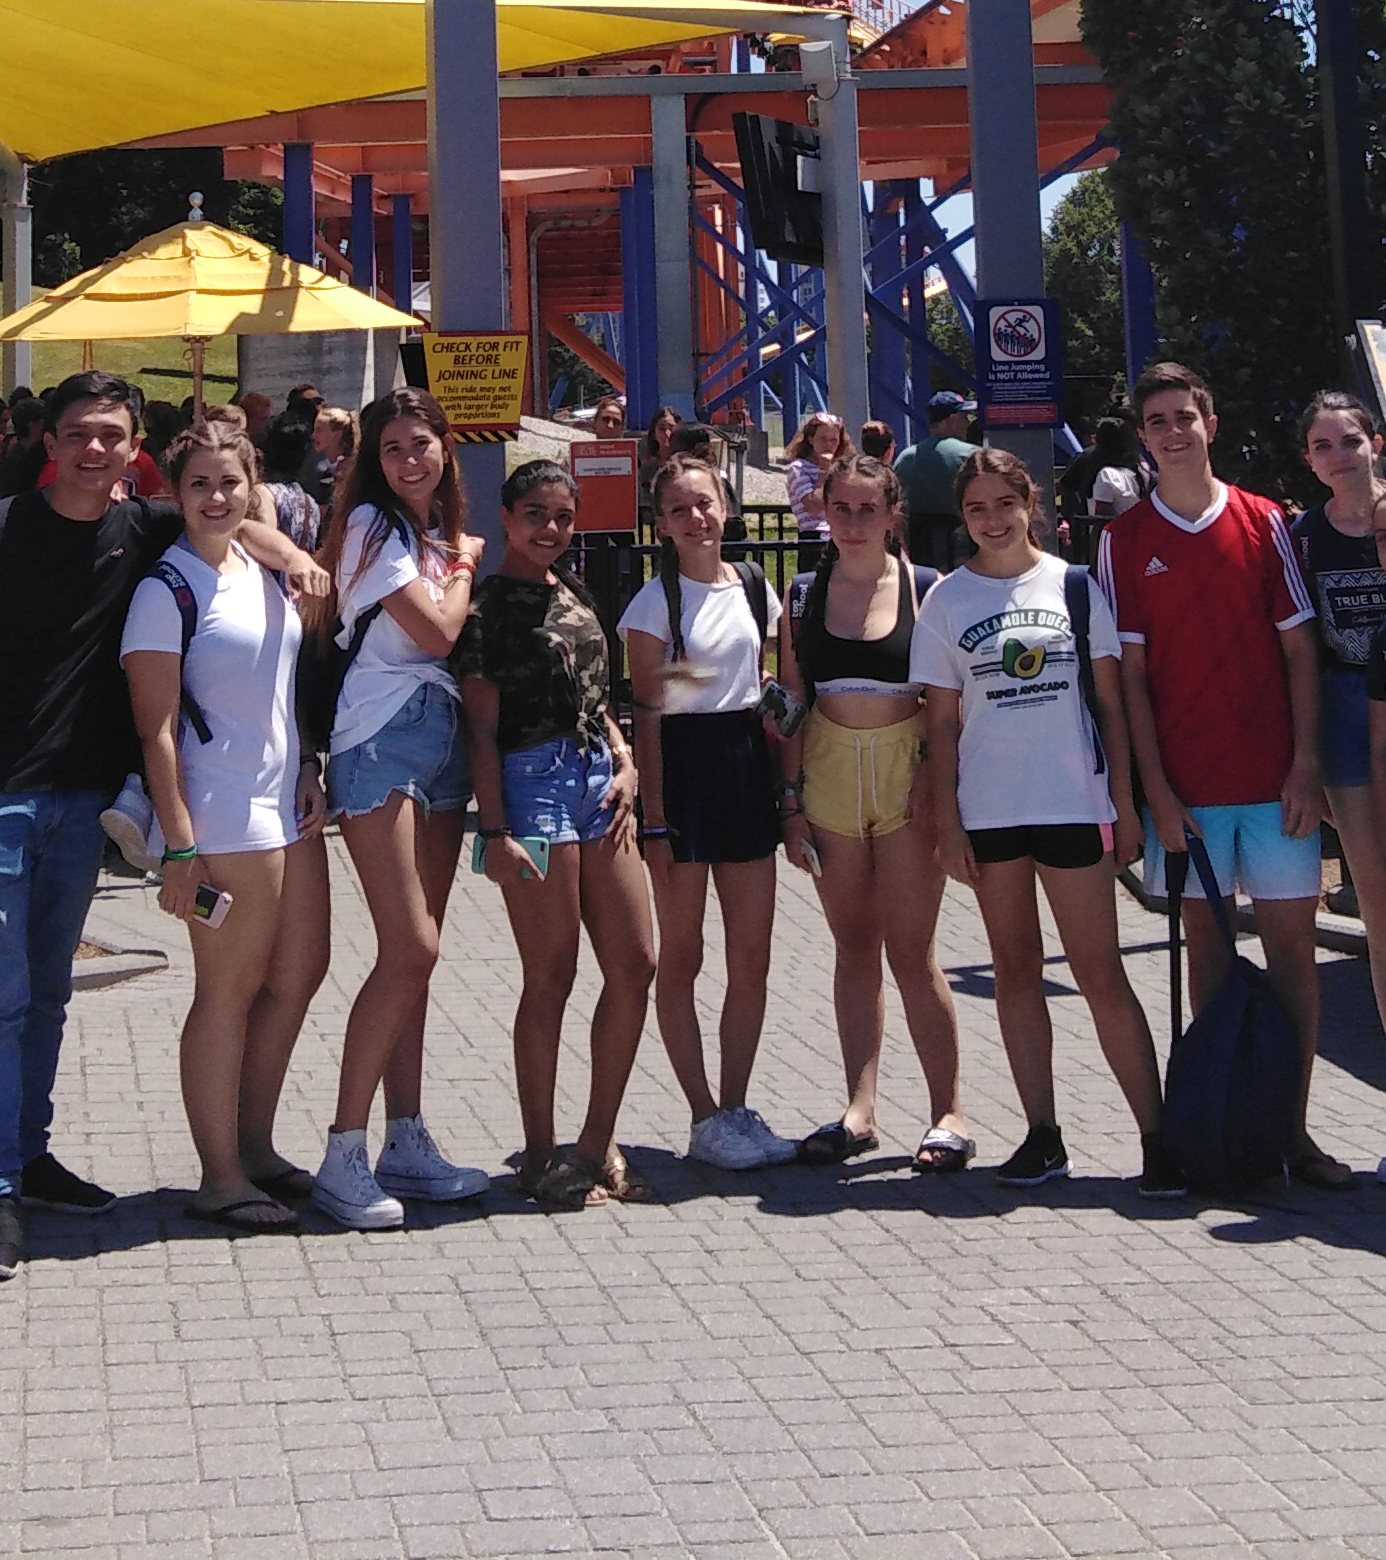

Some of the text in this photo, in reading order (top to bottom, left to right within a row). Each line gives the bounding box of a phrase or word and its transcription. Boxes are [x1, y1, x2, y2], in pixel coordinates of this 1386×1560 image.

[432, 340, 522, 354] CHECK FOR FIT
[453, 354, 502, 366] BEFORE
[992, 362, 1045, 372] Line Jumping
[435, 368, 520, 383] JOINING LINE
[997, 371, 1015, 380] NOT
[1016, 370, 1050, 379] Allowed
[443, 385, 512, 394] This ride may not
[492, 394, 518, 403] guests
[444, 401, 510, 411] with larger body
[454, 411, 501, 421] proportions
[798, 583, 809, 618] school
[1334, 594, 1369, 607] TRUE
[791, 599, 799, 618] top
[960, 611, 1035, 650] GUACAMOLE
[985, 687, 1018, 701] SUPER
[1018, 680, 1070, 696] AVOCADO
